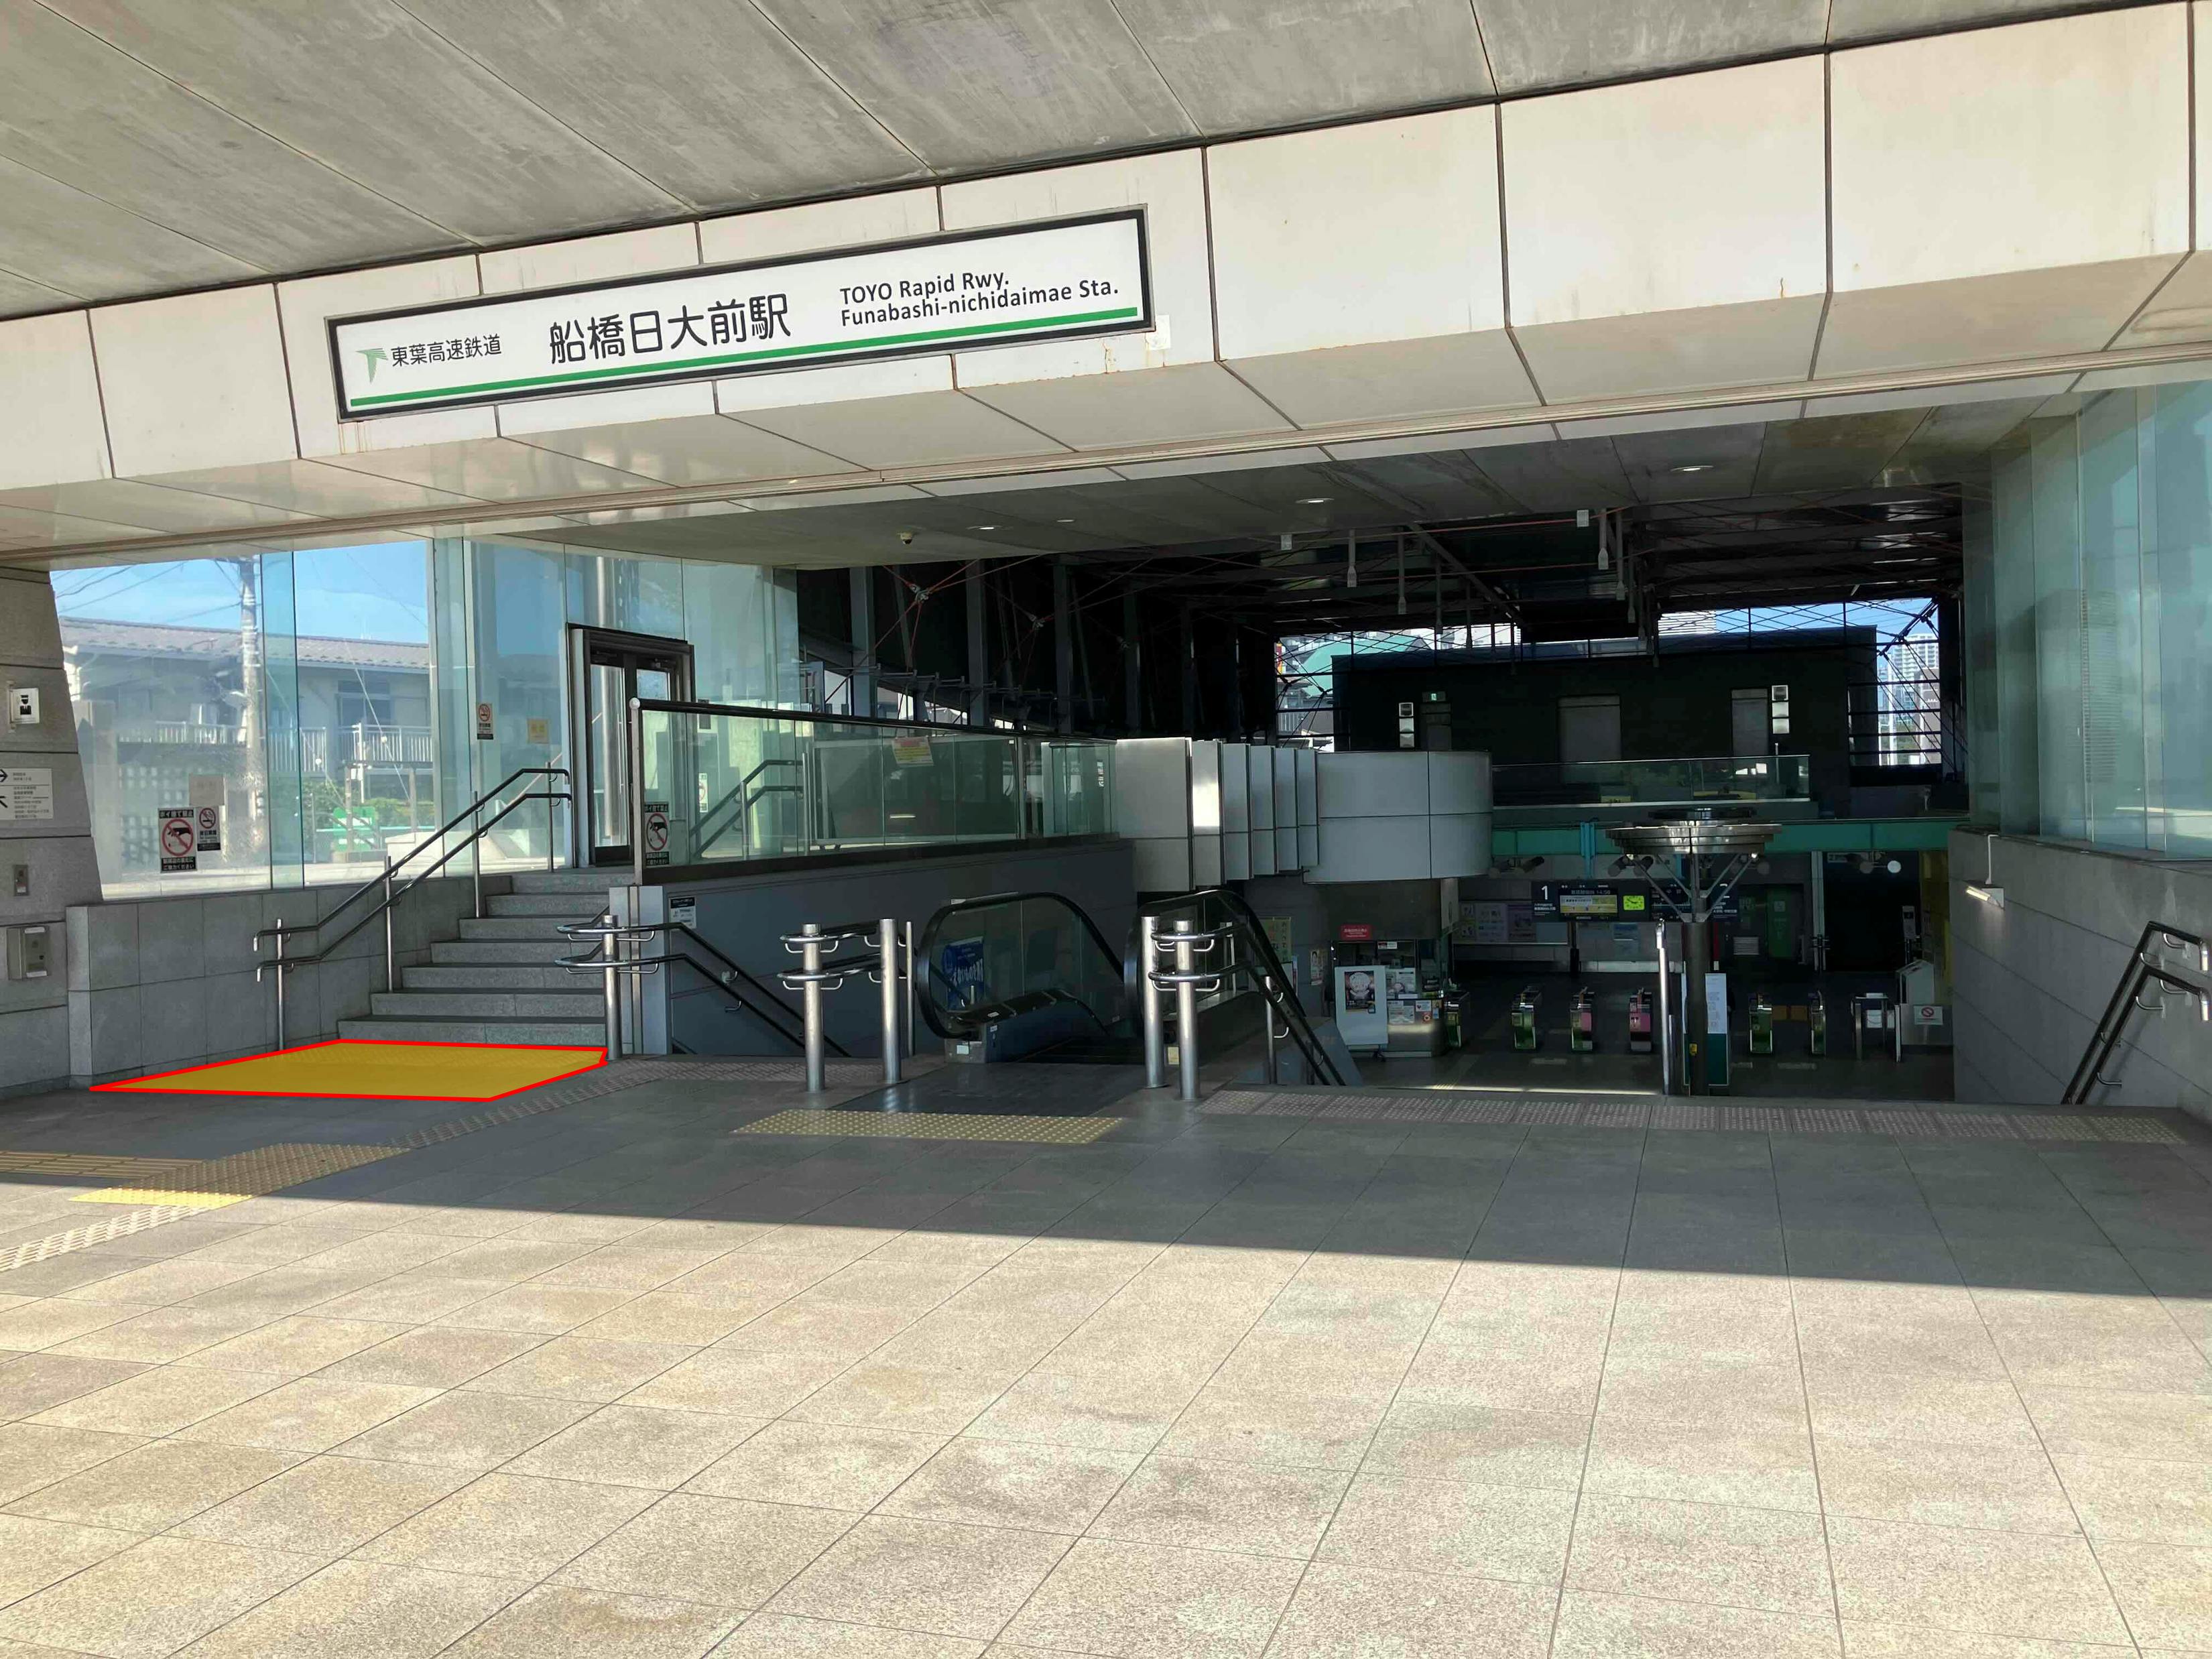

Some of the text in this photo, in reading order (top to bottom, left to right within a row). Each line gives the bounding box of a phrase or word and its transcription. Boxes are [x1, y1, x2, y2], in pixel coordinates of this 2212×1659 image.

[840, 272, 1009, 305] TOYO Rapid Rwy.
[841, 280, 1119, 326] Funabashi-nichidaimae Sta.
[550, 294, 791, 364] 船橋日大前駅
[391, 333, 502, 367] 東葉高速鉄道
[1541, 885, 1548, 900] 1
